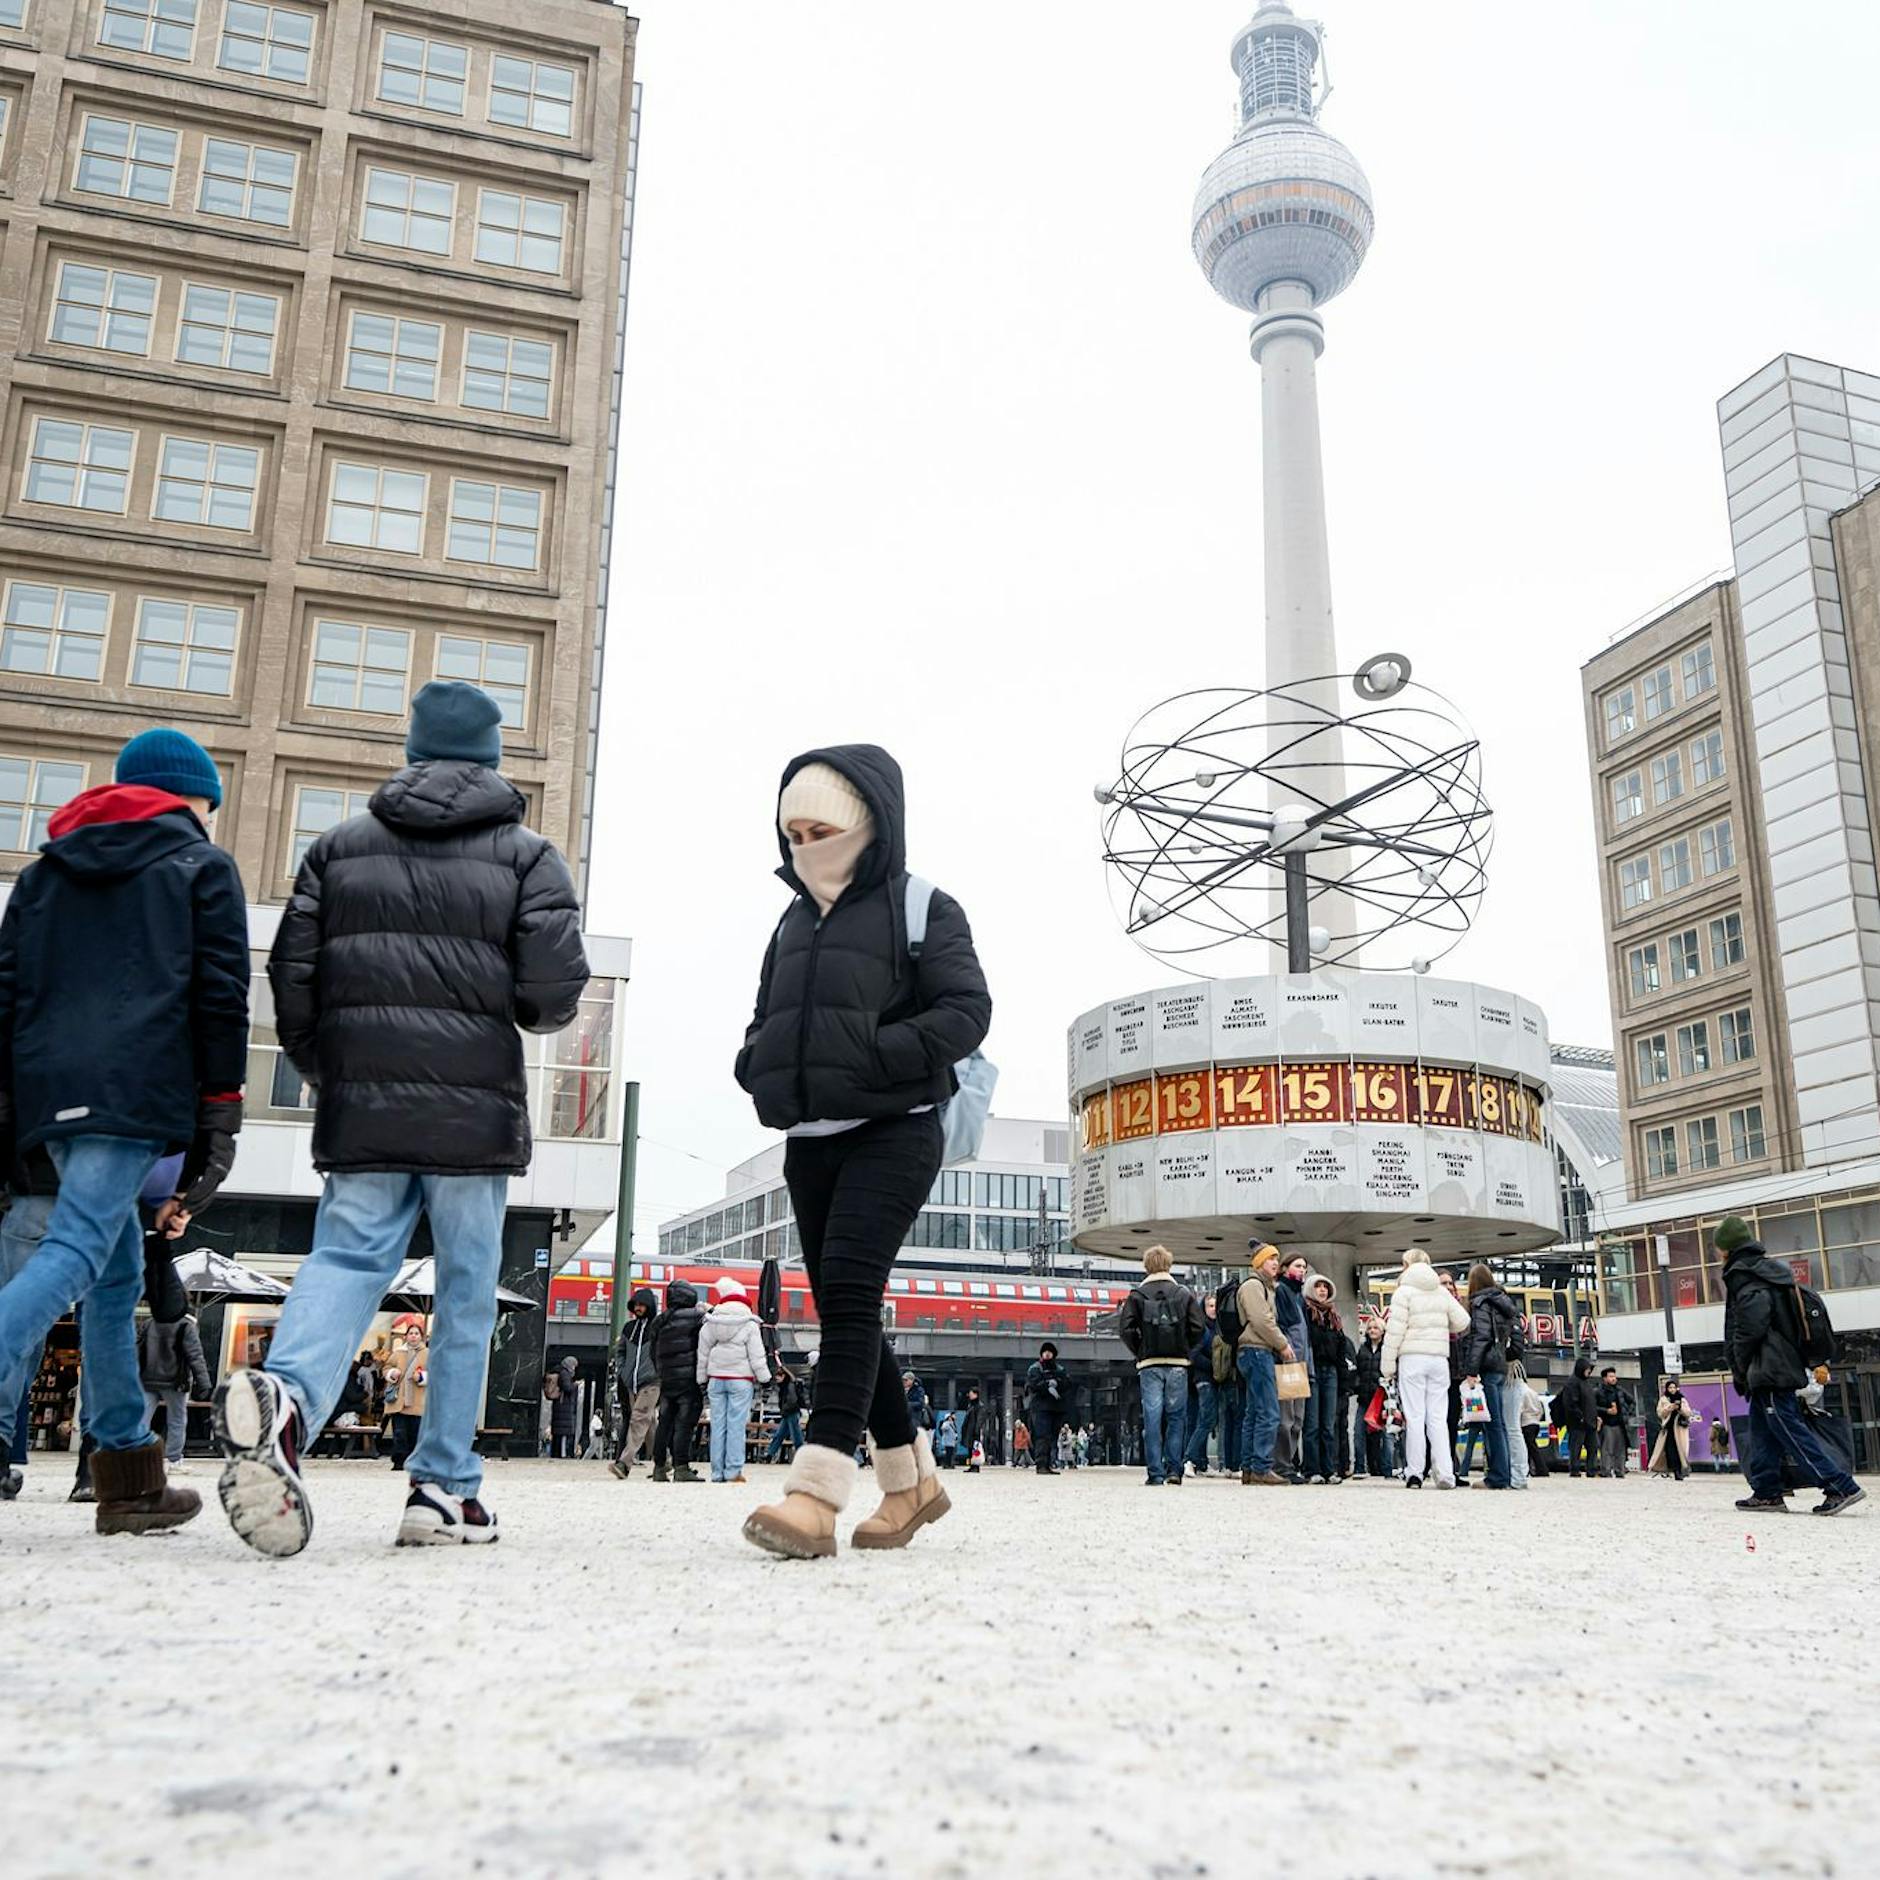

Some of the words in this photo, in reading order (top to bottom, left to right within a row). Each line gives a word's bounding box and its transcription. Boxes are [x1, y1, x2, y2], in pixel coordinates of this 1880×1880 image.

[1120, 1088, 1150, 1128] 12
[1162, 1080, 1201, 1120] 13
[1218, 1074, 1263, 1113] 14
[1283, 1072, 1331, 1110] 15
[1350, 1072, 1398, 1110] 16
[1412, 1076, 1454, 1113] 17
[1467, 1080, 1500, 1121] 18
